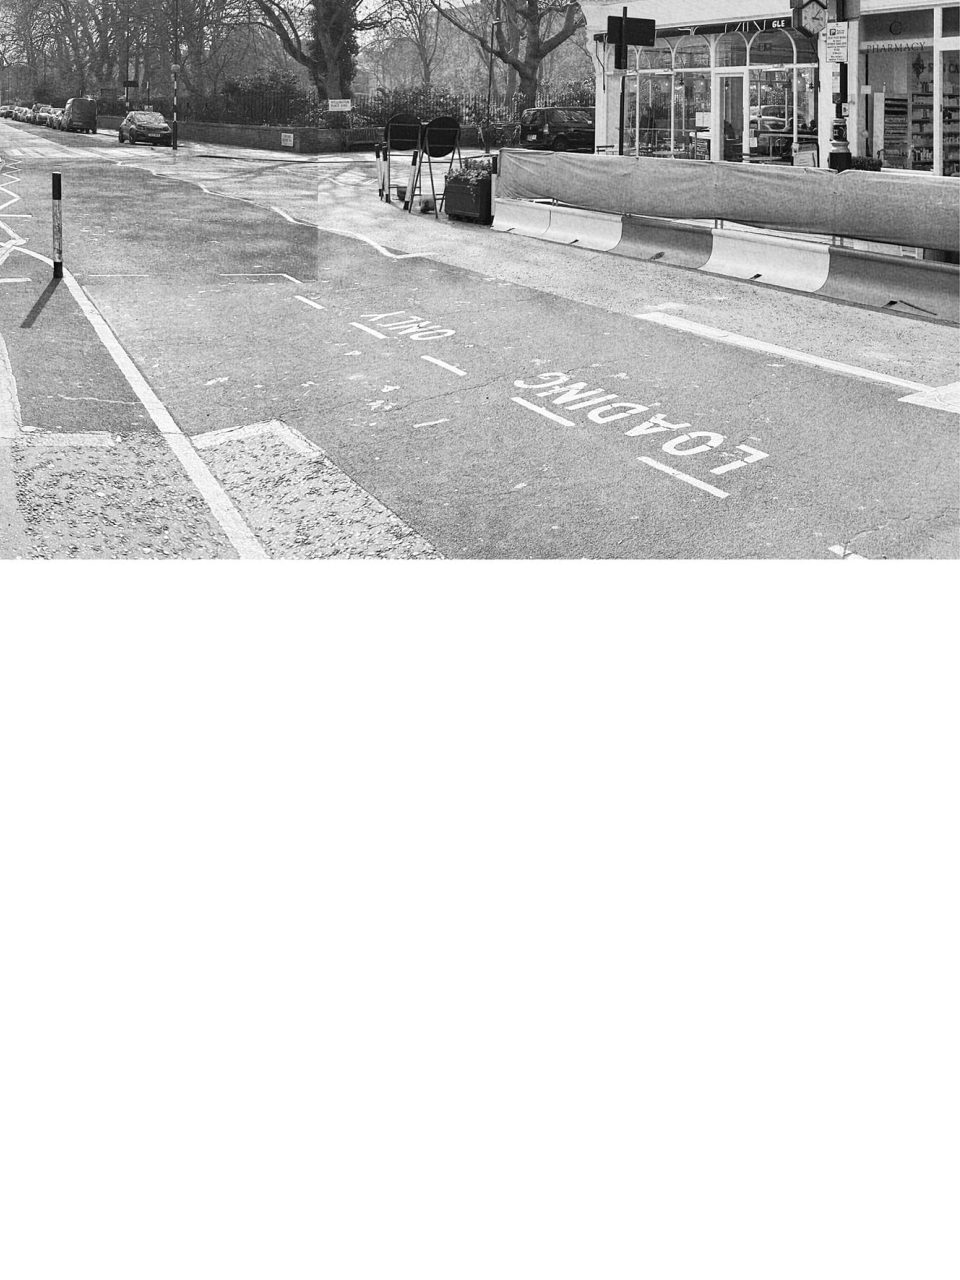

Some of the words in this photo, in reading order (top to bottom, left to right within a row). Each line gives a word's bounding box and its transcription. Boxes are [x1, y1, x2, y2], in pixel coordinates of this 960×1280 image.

[866, 41, 925, 54] PHARMACY
[360, 310, 457, 340] ONLY
[513, 372, 769, 475] LOADING
